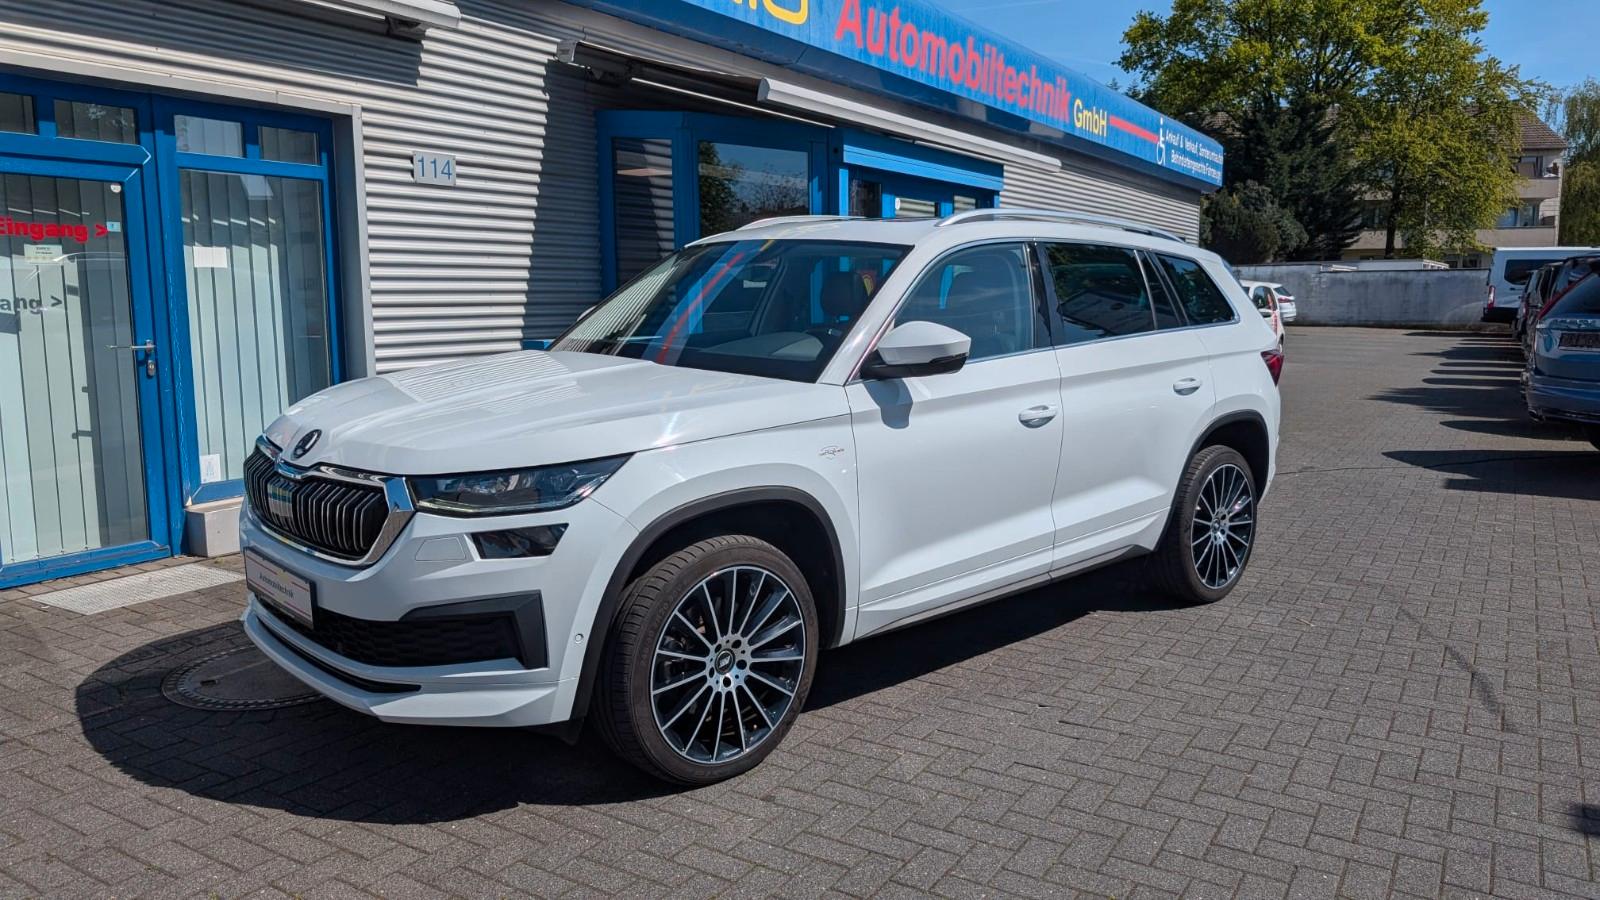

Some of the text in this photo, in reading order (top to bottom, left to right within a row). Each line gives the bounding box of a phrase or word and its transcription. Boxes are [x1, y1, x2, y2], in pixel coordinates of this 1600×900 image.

[834, 0, 1107, 137] Automobiltechnik GmbH
[418, 156, 452, 180] 114
